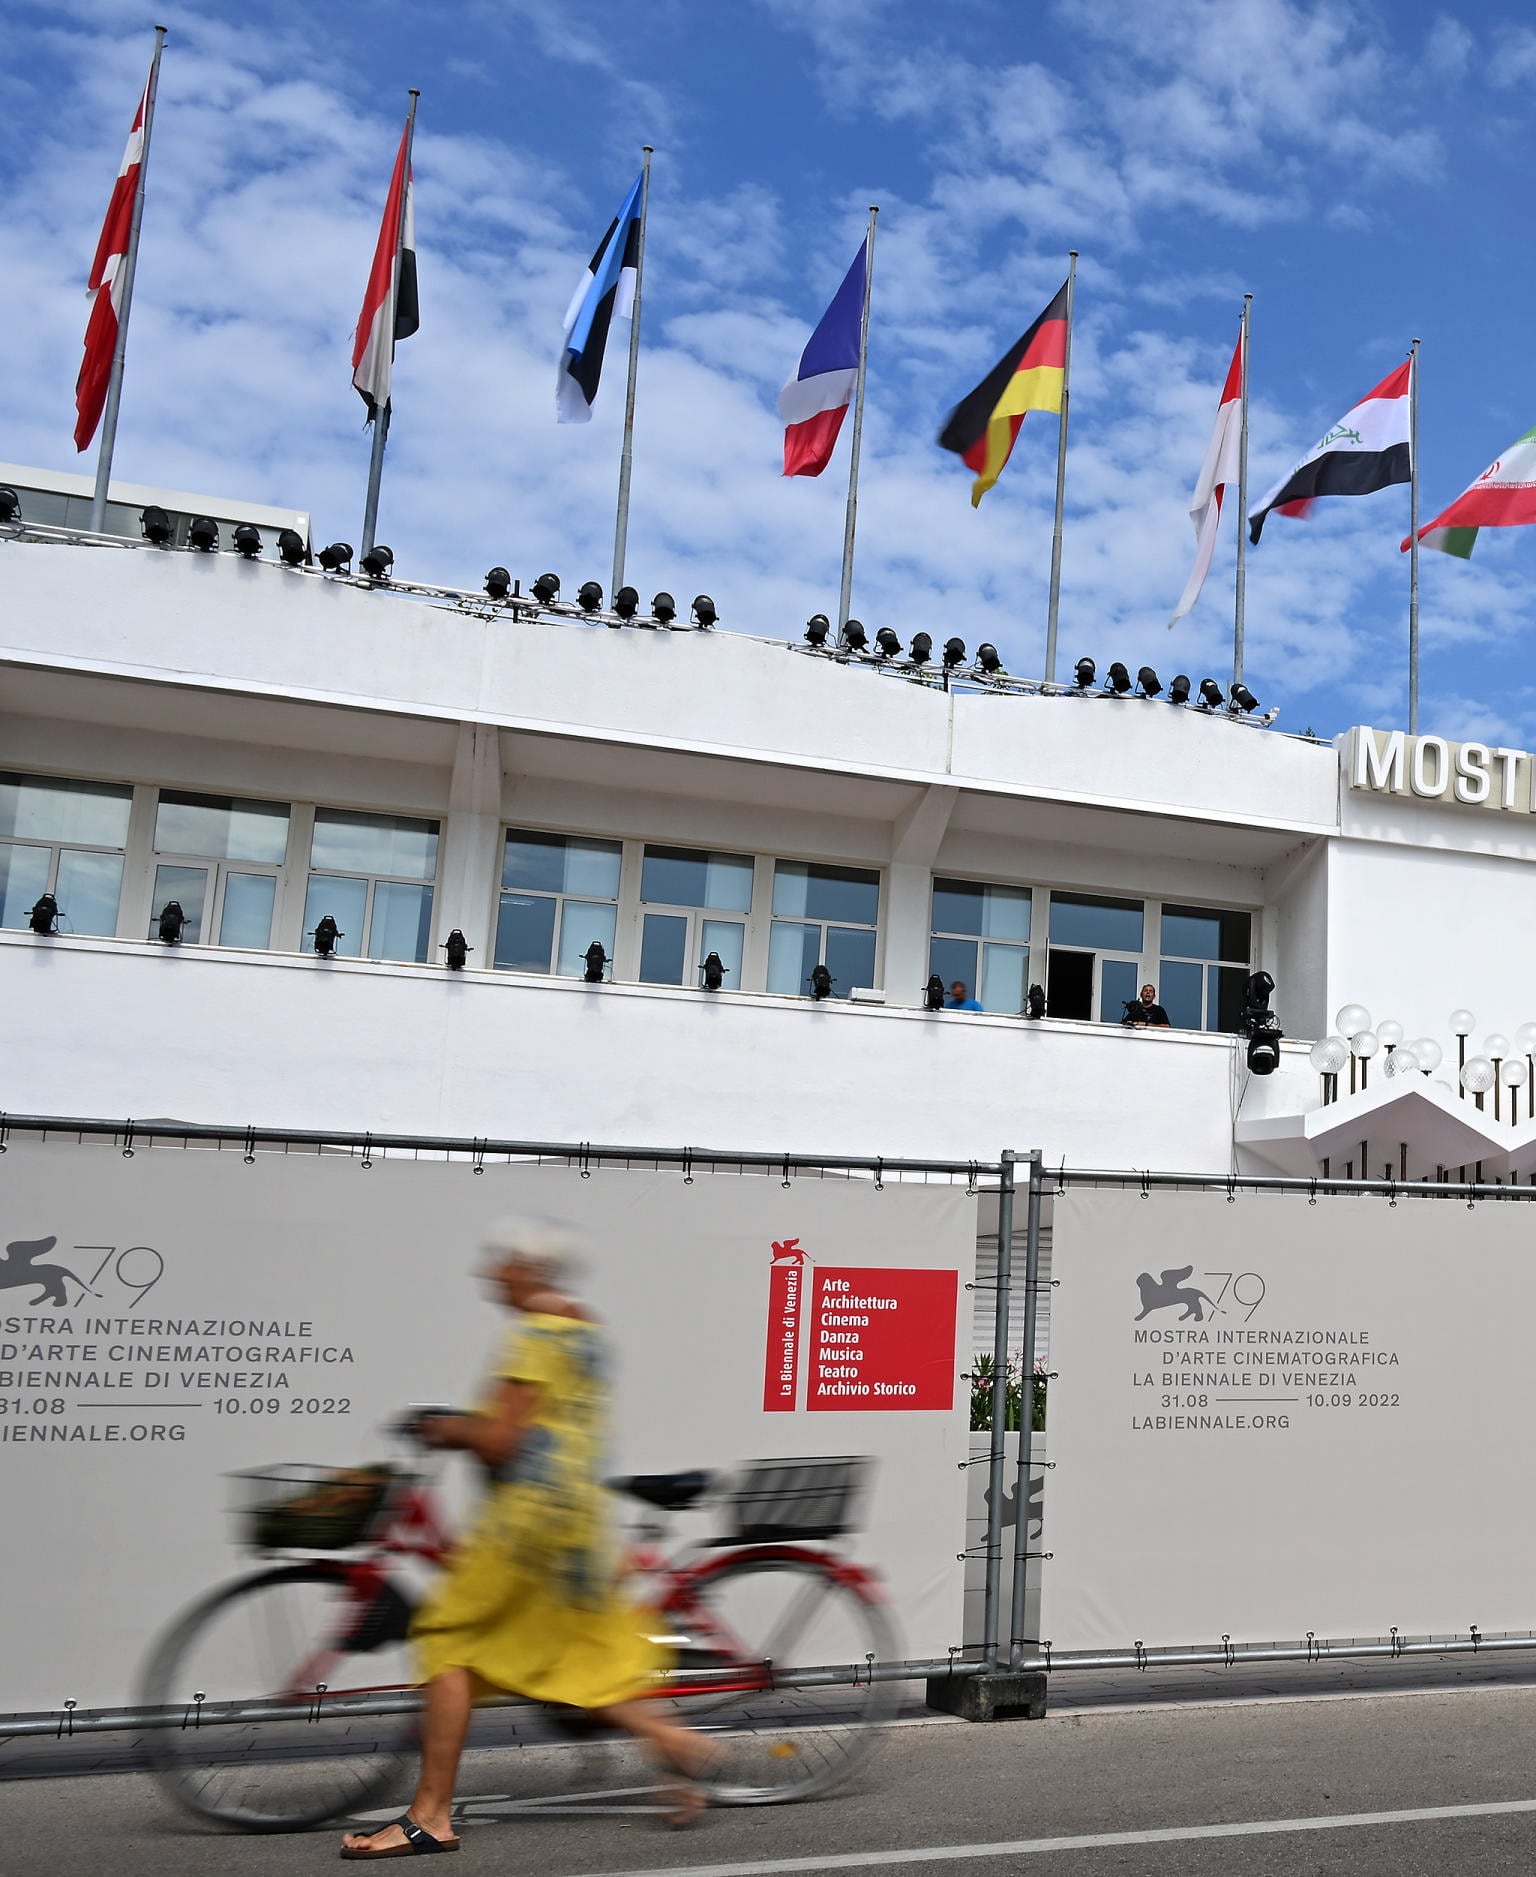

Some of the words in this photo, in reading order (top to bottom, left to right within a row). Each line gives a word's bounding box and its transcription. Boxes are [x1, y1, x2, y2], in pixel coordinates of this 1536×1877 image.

[73, 1246, 164, 1308] 79
[784, 1271, 797, 1313] Venezia
[823, 1279, 850, 1292] Arte
[822, 1295, 897, 1310] Architettura
[1204, 1273, 1265, 1322] 79
[783, 1317, 795, 1327] di
[821, 1312, 869, 1327] Cinema
[0, 1318, 73, 1334] STRA
[86, 1319, 312, 1336] INTERNAZIONALE
[820, 1331, 859, 1343] Danza
[1135, 1330, 1209, 1343] MOSTRA
[1218, 1331, 1368, 1344] INTERNAZIONALE
[1, 1345, 97, 1360] D'ARTE
[109, 1345, 353, 1362] CINEMATOGRAFICA
[780, 1332, 794, 1380] Biennale
[820, 1348, 863, 1361] Musica
[1163, 1352, 1225, 1364] D'ARTE
[1234, 1352, 1399, 1365] CINEMATOGRAFICA
[819, 1365, 858, 1378] Teatro
[0, 1371, 133, 1387] BIENNALE
[145, 1372, 169, 1387] DI
[181, 1373, 288, 1388] VENEZIA
[1134, 1373, 1154, 1386] LA
[1163, 1373, 1251, 1386] BIENNALE
[1260, 1373, 1275, 1385] DI
[1283, 1373, 1356, 1385] VENEZIA
[781, 1384, 791, 1395] La
[818, 1381, 870, 1395] Archivio
[874, 1382, 916, 1395] Storico
[214, 1399, 279, 1414] 10.09
[290, 1399, 350, 1413] 2022
[1162, 1395, 1207, 1407] 31.08
[1307, 1394, 1351, 1406] 10.09
[1359, 1394, 1399, 1406] 2022
[1133, 1416, 1289, 1429] LABIENNALE.ORG
[3, 1425, 184, 1441] IENNALE.ORG
